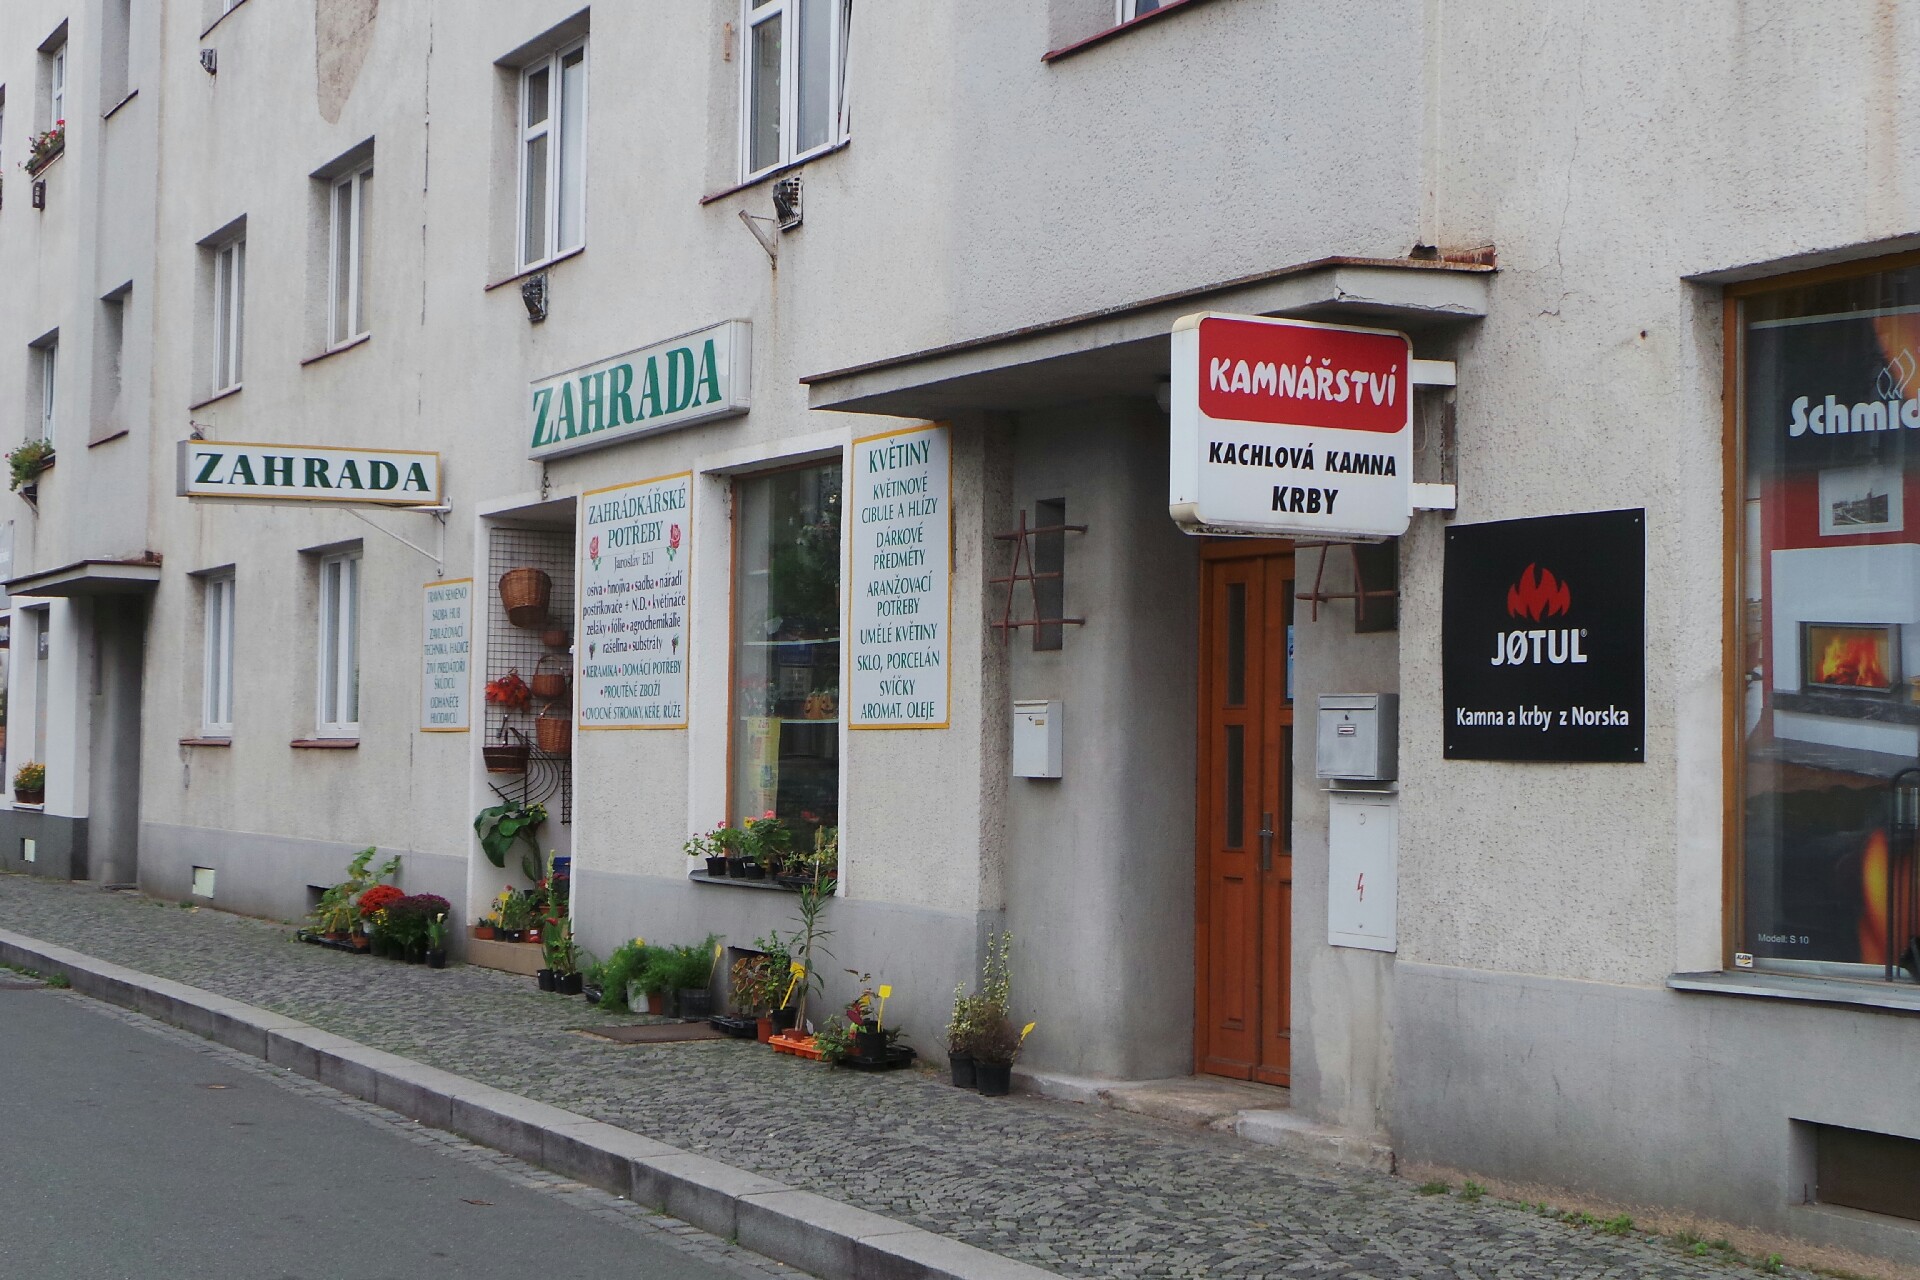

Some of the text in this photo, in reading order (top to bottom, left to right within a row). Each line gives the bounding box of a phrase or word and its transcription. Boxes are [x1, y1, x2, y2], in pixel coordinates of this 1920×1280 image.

[531, 338, 722, 448] ZAHRADA
[1210, 355, 1398, 407] KAMNÁŘSTVÍ
[1789, 388, 1920, 437] Schmid
[869, 438, 931, 474] KVĚTINY
[1208, 441, 1396, 476] KACHLOVÁ KAMNA
[194, 453, 431, 492] ZAHRADA
[873, 470, 928, 500] KVĚTINOVÉ
[588, 482, 686, 525] ZAHRÁDKÁŘSKÉ
[861, 494, 938, 524] CIBULE A HLÍZY
[1271, 485, 1339, 515] KRBY
[607, 519, 664, 549] POTŘEBY
[876, 521, 923, 548] DÁRKOVÉ
[873, 545, 926, 571] PŘEDMĚTY
[586, 569, 683, 597] osiva hnojiva sadba nářadí
[867, 570, 933, 597] ARANŽOVACÍ
[583, 598, 623, 620] postřikovače
[631, 596, 647, 612] N.D.
[652, 591, 686, 610] květináče
[877, 595, 920, 617] POTŘEBY
[610, 617, 625, 634] fólie
[629, 611, 681, 636] agrochemikálie
[860, 620, 938, 645] UMĚLÉ KVĚTINY
[602, 634, 663, 654] rašelina substráty
[586, 656, 682, 678] KERAMIKA DOMÁCÍ POTŘEBY
[857, 645, 940, 673] SKLO, PORCELÁN
[603, 680, 661, 699] PROUTĚNÉ ZBOŽÍ
[879, 674, 915, 697] SVÍČKY
[585, 702, 612, 720] OVOCNÉ
[663, 700, 681, 719] RŮŽE
[860, 701, 935, 720] AROMAT. OLEJE
[1456, 705, 1629, 732] Kamna a krby z Norska
[1758, 933, 1809, 944] Modell: S 10
